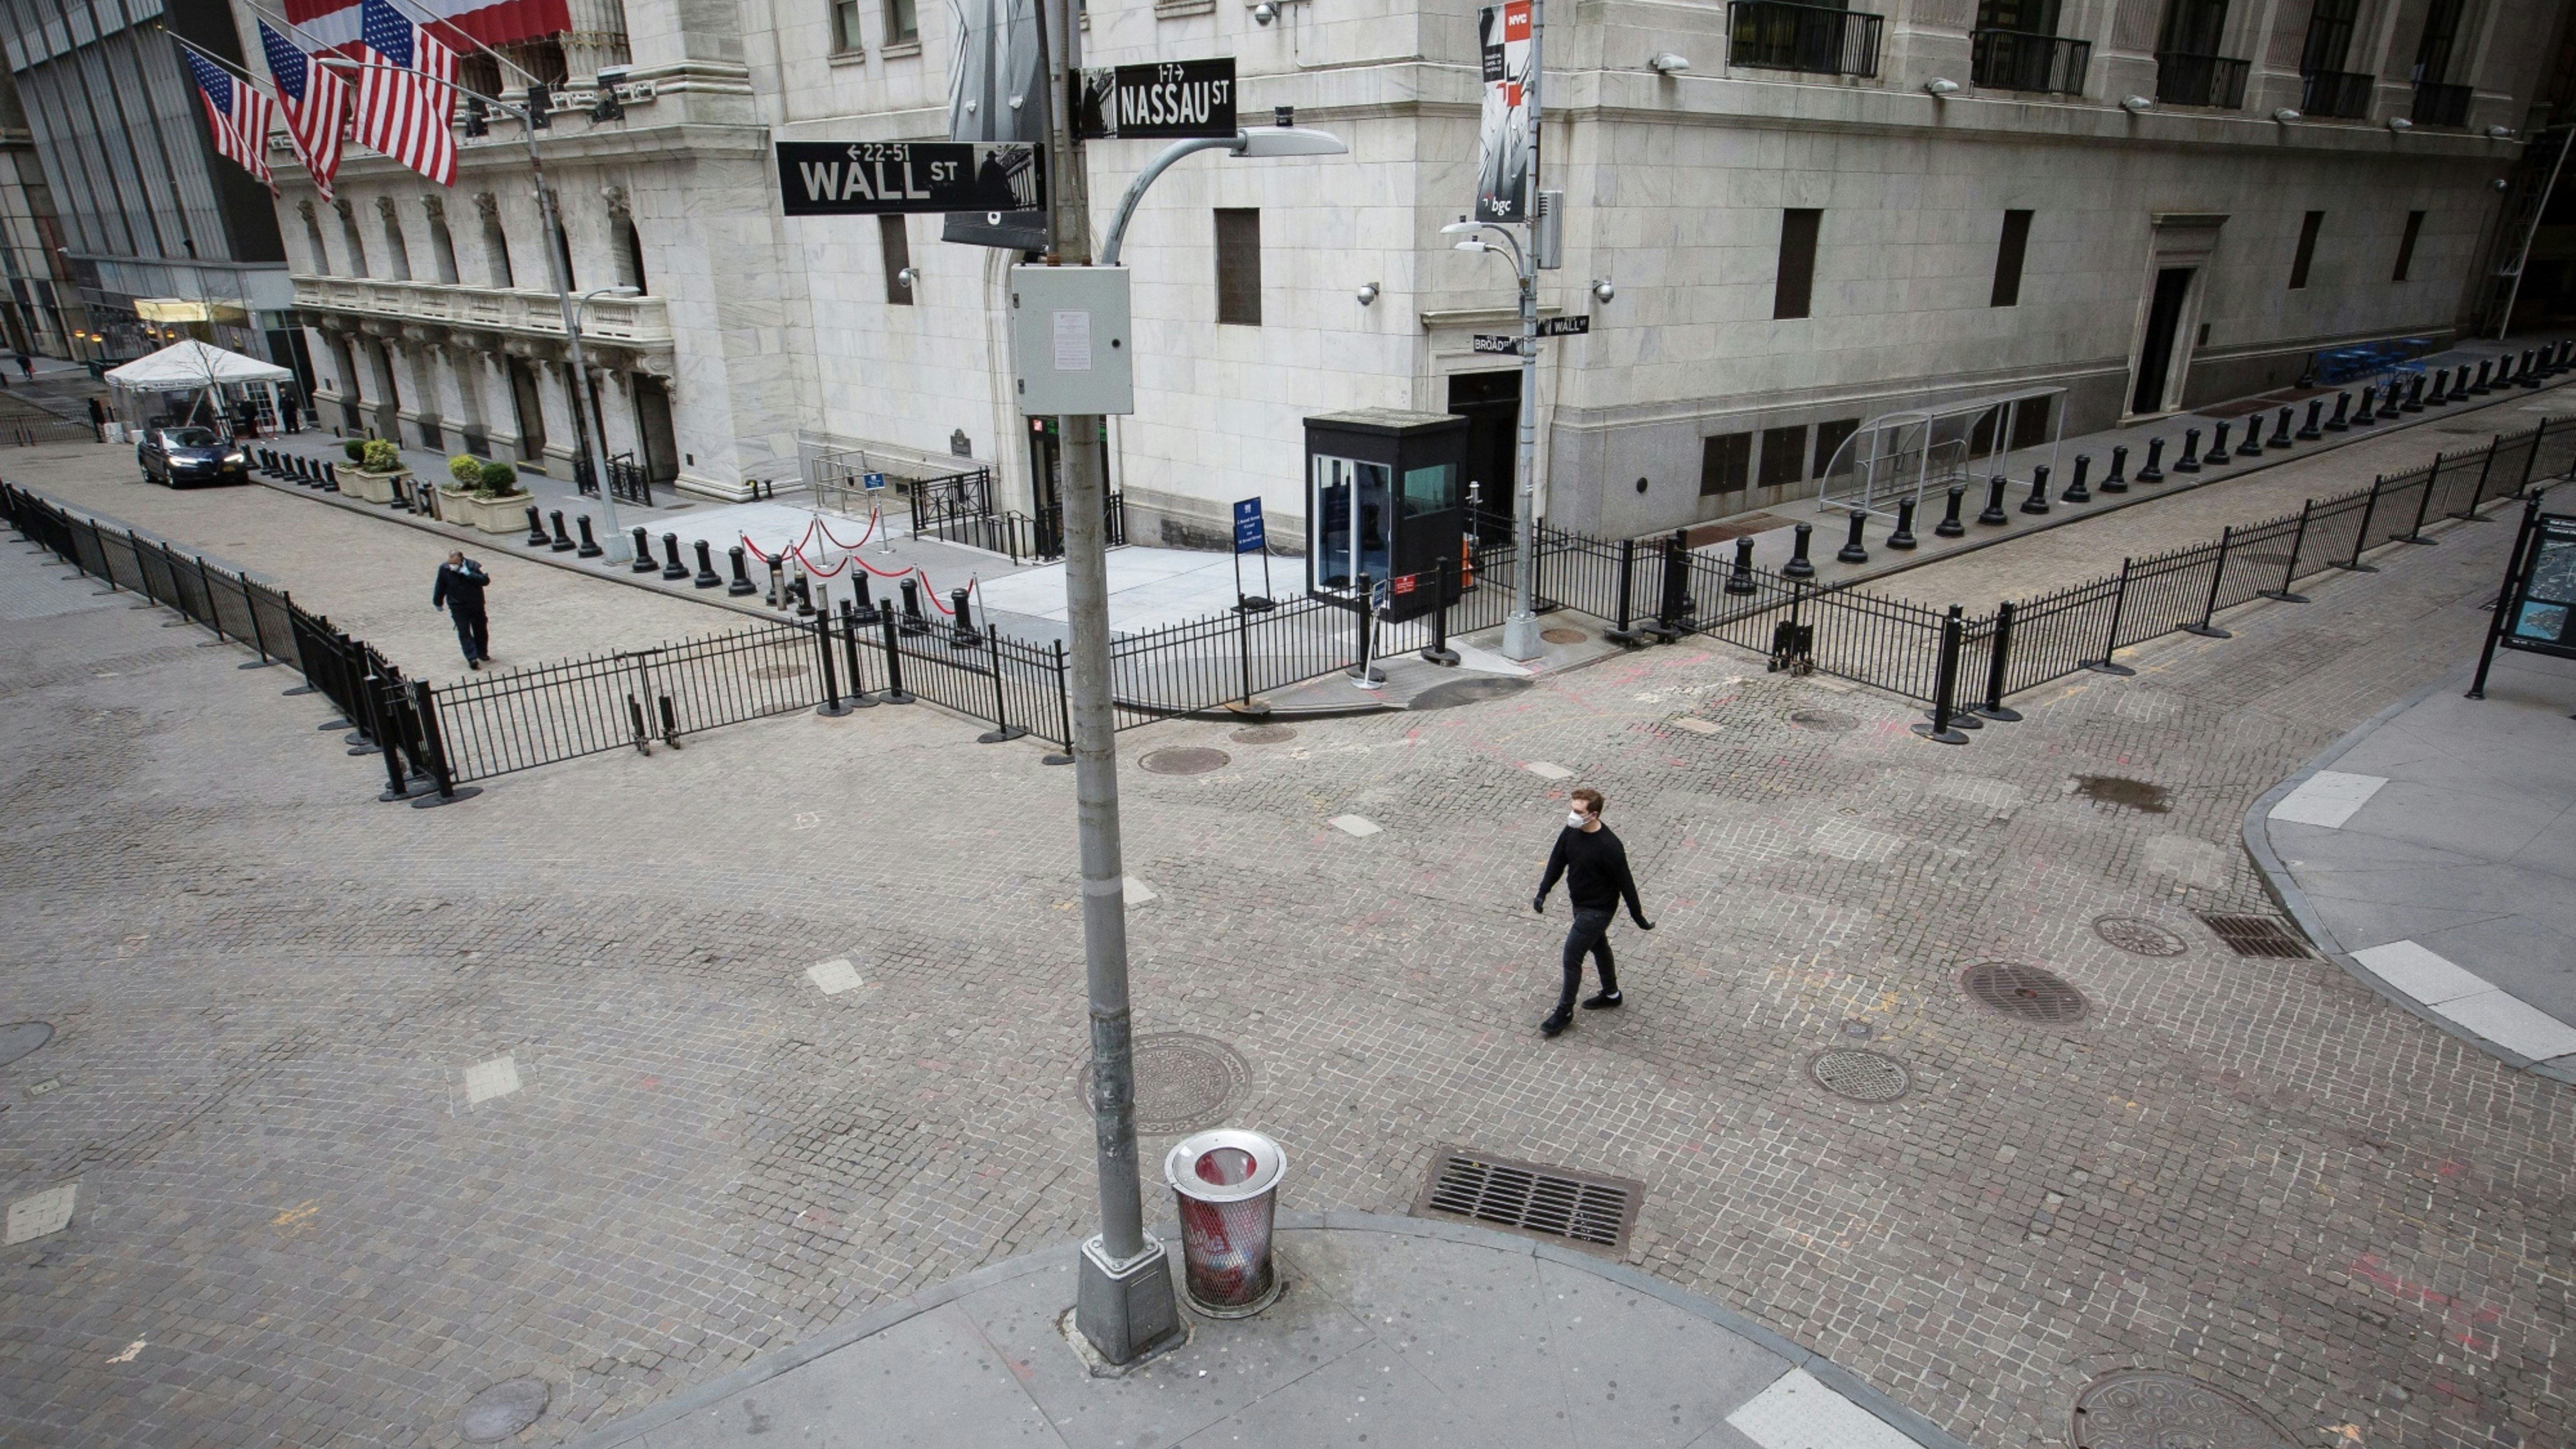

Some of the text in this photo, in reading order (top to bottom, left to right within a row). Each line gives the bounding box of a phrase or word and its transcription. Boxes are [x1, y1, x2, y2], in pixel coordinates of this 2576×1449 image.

[1509, 14, 1527, 26] NYC
[1158, 64, 1173, 83] 1-7
[1121, 80, 1229, 125] NASSAU ST
[864, 144, 910, 161] 22-51
[799, 161, 957, 201] WALL ST
[1491, 196, 1512, 216] bgc
[1554, 320, 1579, 333] WALL
[1475, 339, 1504, 351] BROAD
